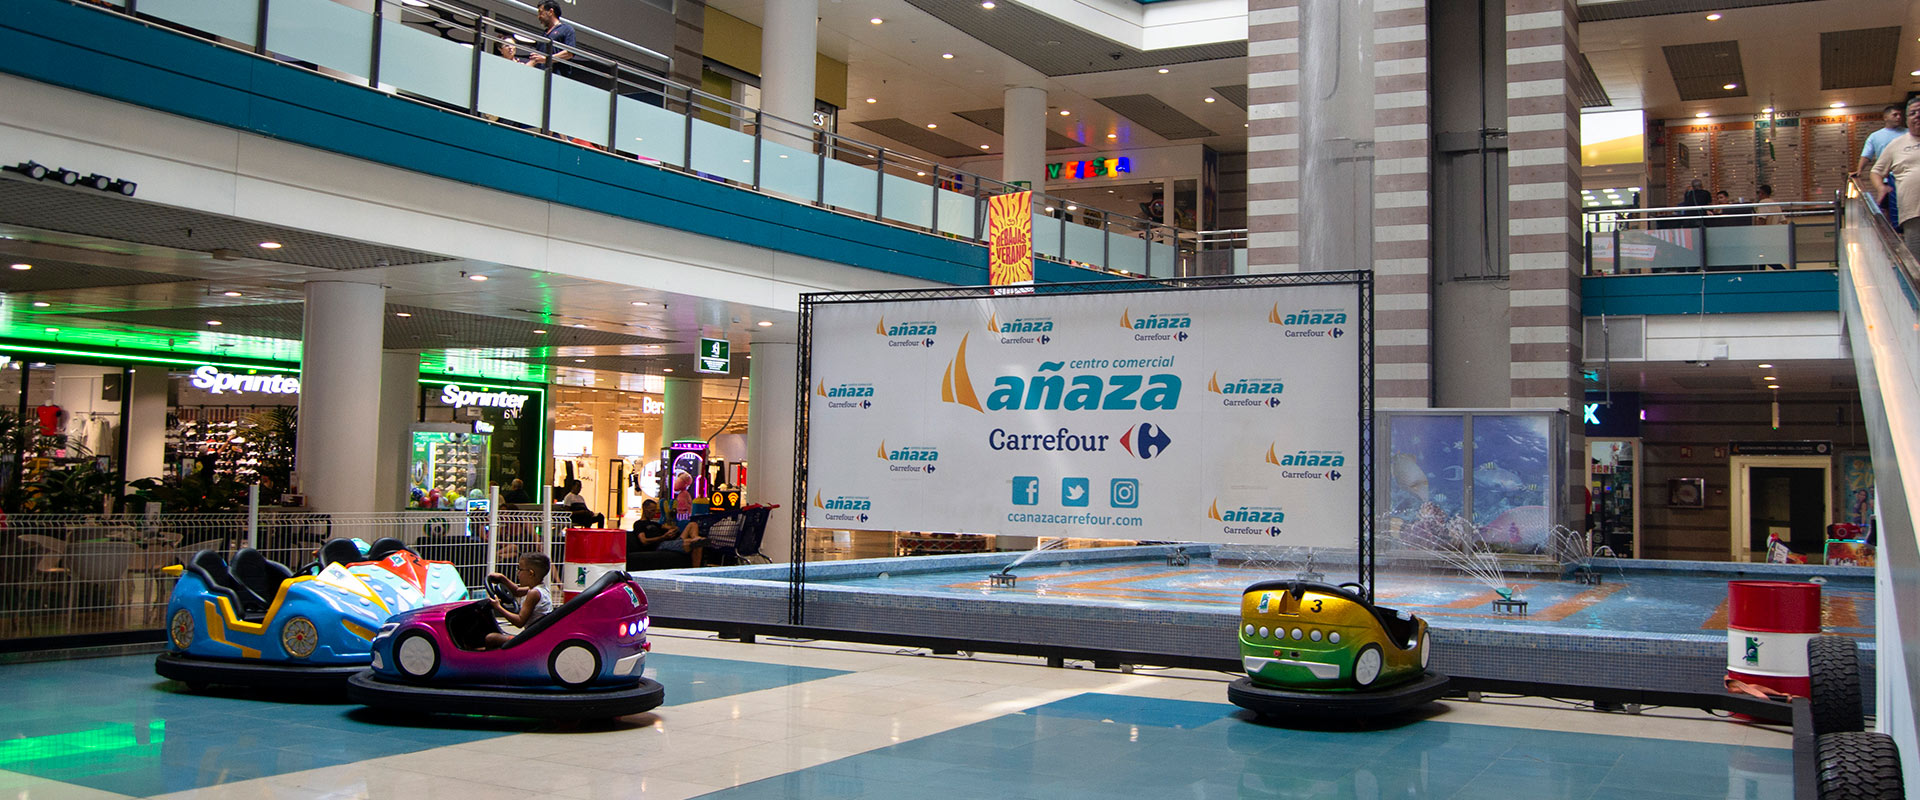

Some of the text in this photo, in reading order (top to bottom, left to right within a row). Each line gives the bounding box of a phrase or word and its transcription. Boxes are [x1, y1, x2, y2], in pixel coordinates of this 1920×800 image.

[1691, 124, 1718, 132] PLANTA
[1065, 156, 1131, 180] FIESTA
[996, 227, 1027, 247] REBAJAS
[996, 245, 1027, 265] VERANO
[1133, 314, 1192, 329] añaza
[1284, 309, 1347, 325] añaza
[888, 322, 938, 336] añaza
[1000, 318, 1054, 333] añaza
[1000, 336, 1035, 344] Carrefour
[1134, 333, 1171, 341] Carrefour
[1284, 329, 1325, 338] Carrefour
[888, 339, 920, 347] Carrefour
[1069, 354, 1175, 370] centro comercial
[828, 383, 875, 398] añaza
[986, 360, 1183, 411] añaza
[1222, 378, 1285, 395] añaza
[440, 384, 529, 408] Sprinter
[1223, 398, 1263, 407] Carrefour
[828, 400, 858, 409] Carrefour
[988, 427, 1110, 452] Carrefour
[889, 446, 939, 461] añaza
[1280, 451, 1346, 467] añaza
[889, 464, 921, 473] Carrefour
[1281, 470, 1323, 479] Carrefour
[825, 496, 872, 511] añaza
[825, 513, 855, 522] Carrefour
[1007, 512, 1143, 527] ccanazacarrefour.com
[1222, 506, 1285, 523] añaza
[1223, 526, 1263, 536] Carrefour
[1310, 599, 1323, 613] 3
